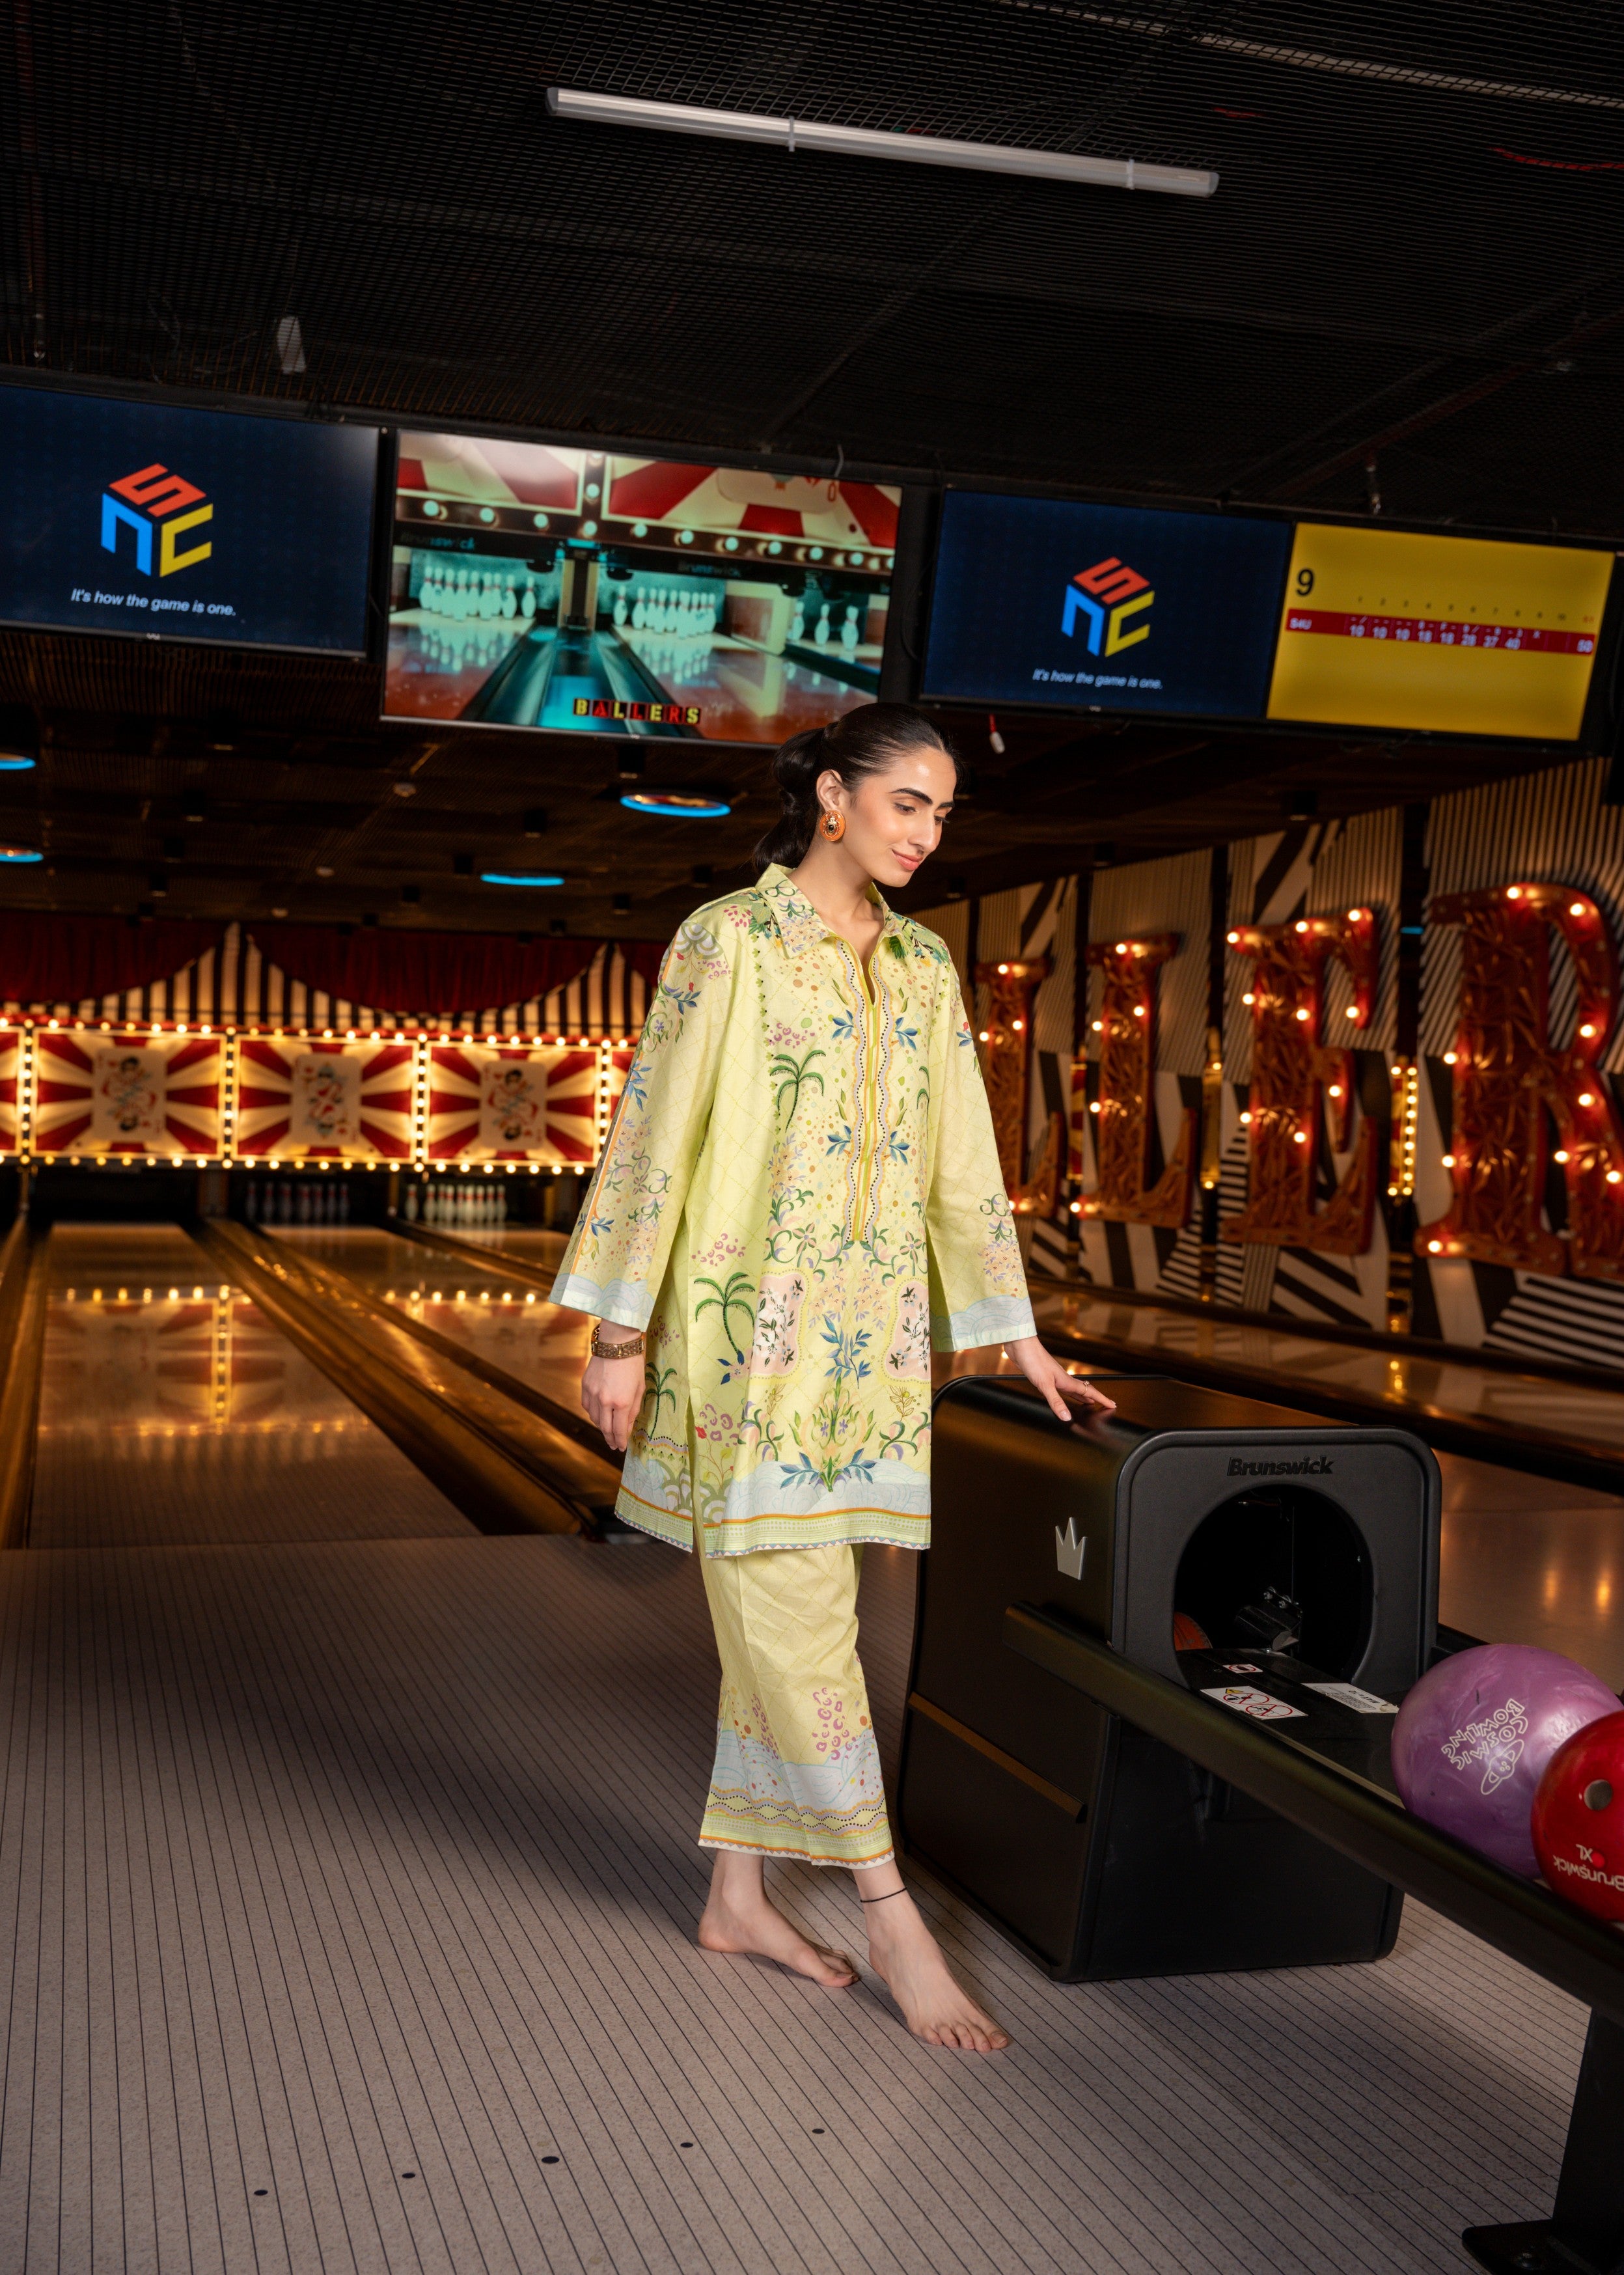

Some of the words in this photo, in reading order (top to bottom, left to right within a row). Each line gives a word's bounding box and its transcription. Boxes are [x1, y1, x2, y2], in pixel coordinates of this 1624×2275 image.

[1297, 568, 1314, 596] 9
[71, 588, 91, 603] It's
[94, 590, 124, 605] how
[126, 594, 148, 608] the
[151, 598, 190, 612] game
[192, 600, 204, 613] is
[207, 604, 236, 616] one.
[1032, 668, 1050, 681] It's
[1050, 670, 1075, 682] how
[1075, 672, 1095, 684] the
[1095, 675, 1127, 687] game
[1127, 675, 1138, 687] is
[1139, 678, 1163, 689] one.
[575, 698, 700, 724] BALLERS
[1227, 1455, 1334, 1476] Brunswick
[1441, 1698, 1525, 1758] BOWLING
[1450, 1716, 1528, 1771] COSMIC
[1576, 1843, 1593, 1863] XL
[1553, 1854, 1624, 1892] Brunswick
